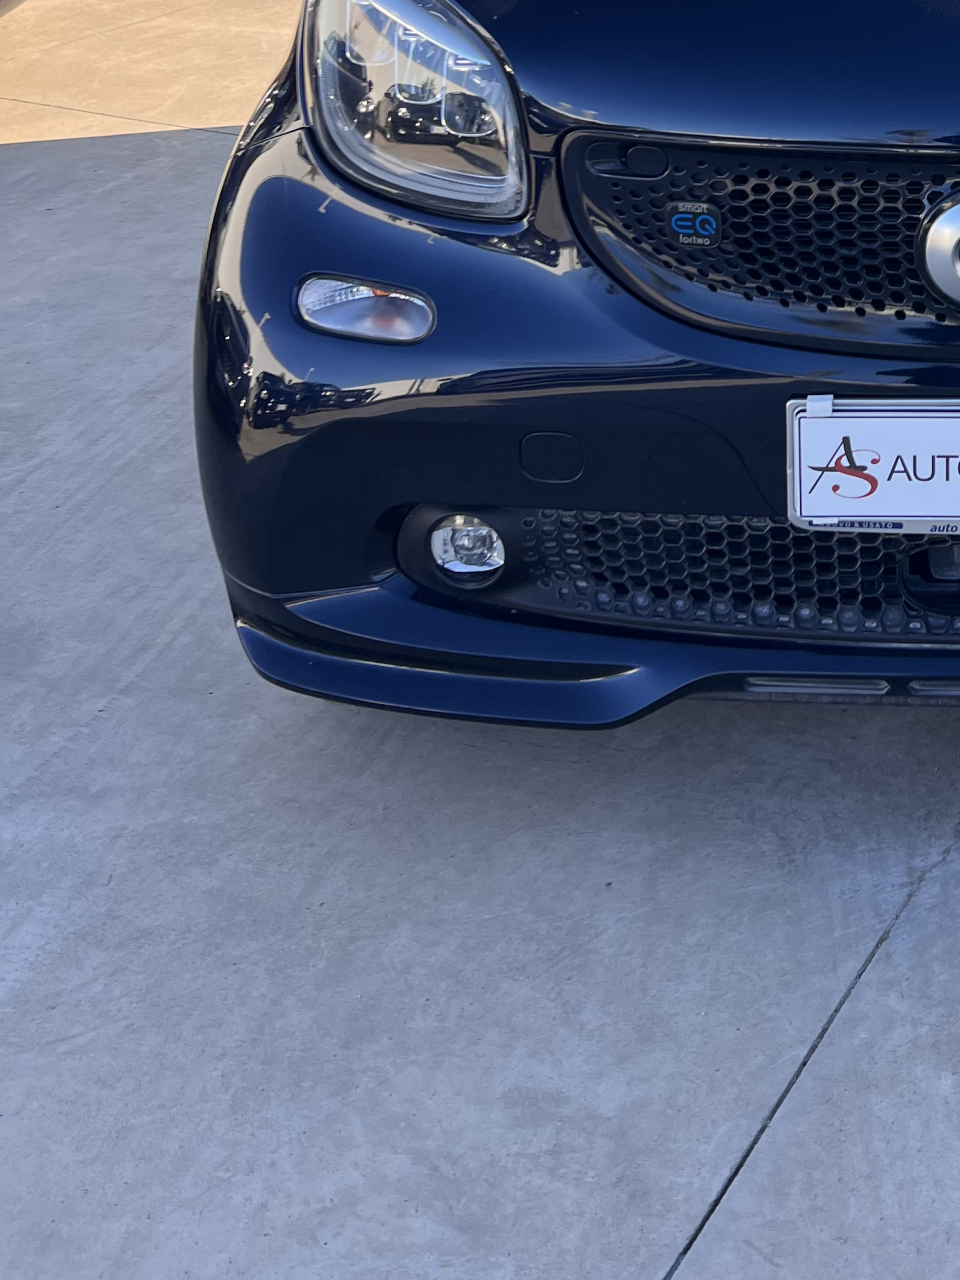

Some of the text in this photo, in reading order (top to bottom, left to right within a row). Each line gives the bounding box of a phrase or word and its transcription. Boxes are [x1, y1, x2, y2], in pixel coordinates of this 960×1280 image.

[678, 204, 708, 213] smart
[671, 214, 716, 235] EQ
[679, 233, 711, 245] fortwo
[862, 521, 893, 529] USATO
[929, 523, 958, 533] auto
